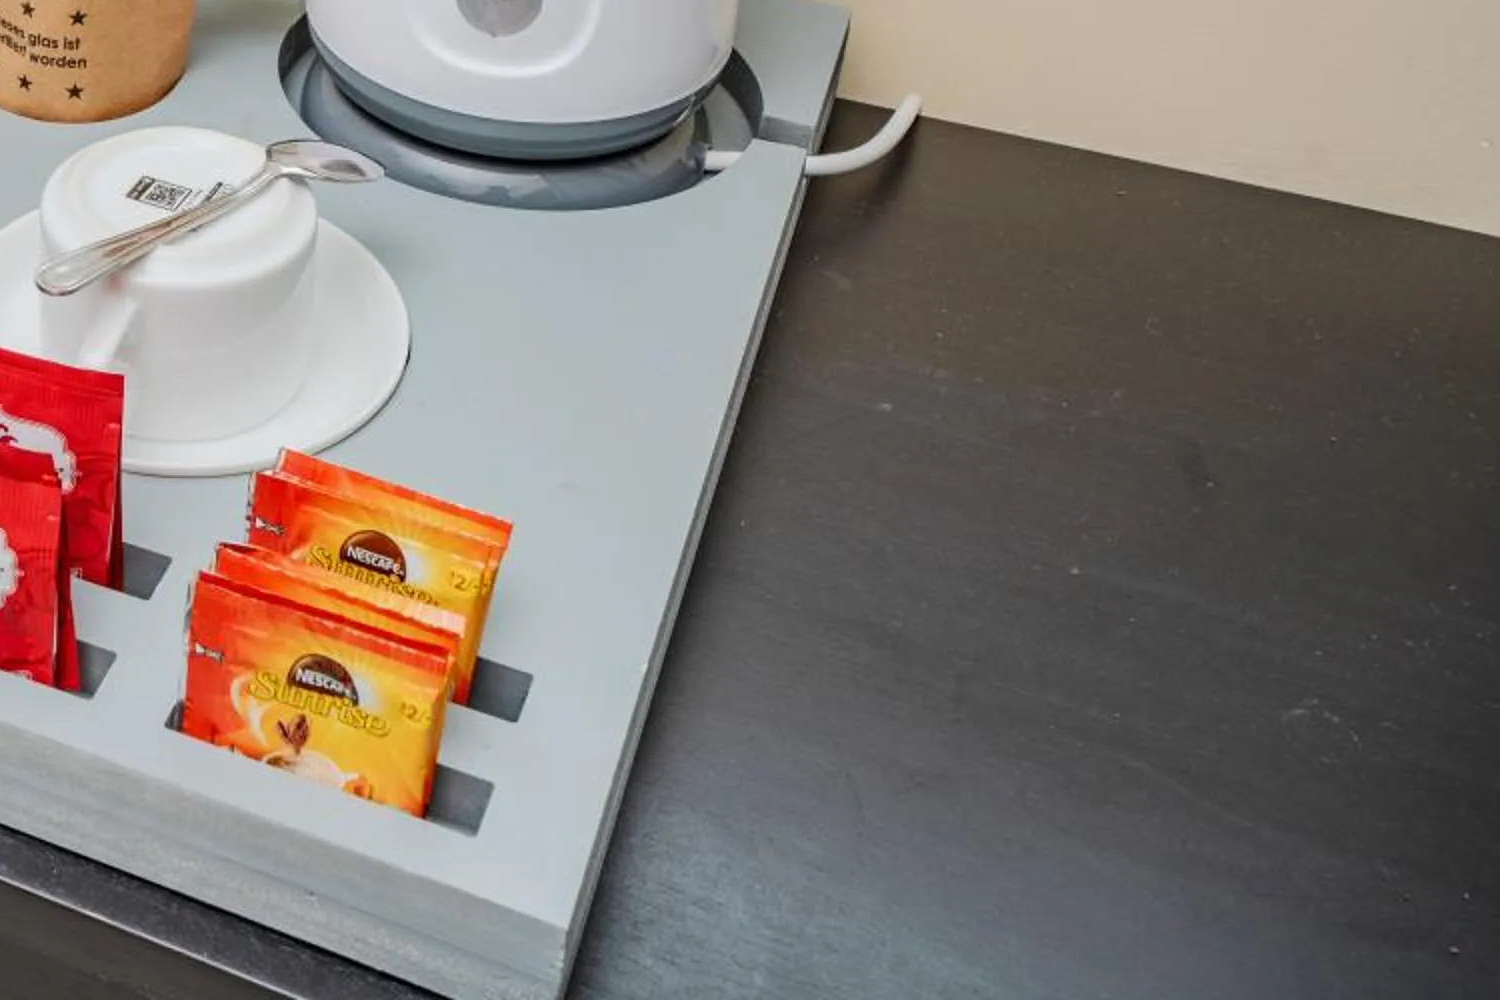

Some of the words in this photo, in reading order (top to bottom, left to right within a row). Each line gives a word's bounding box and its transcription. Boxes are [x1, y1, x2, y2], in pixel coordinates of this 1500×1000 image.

[28, 31, 59, 50] glas
[63, 36, 81, 51] ist
[29, 51, 88, 69] worden
[248, 670, 390, 739] Sunrise
